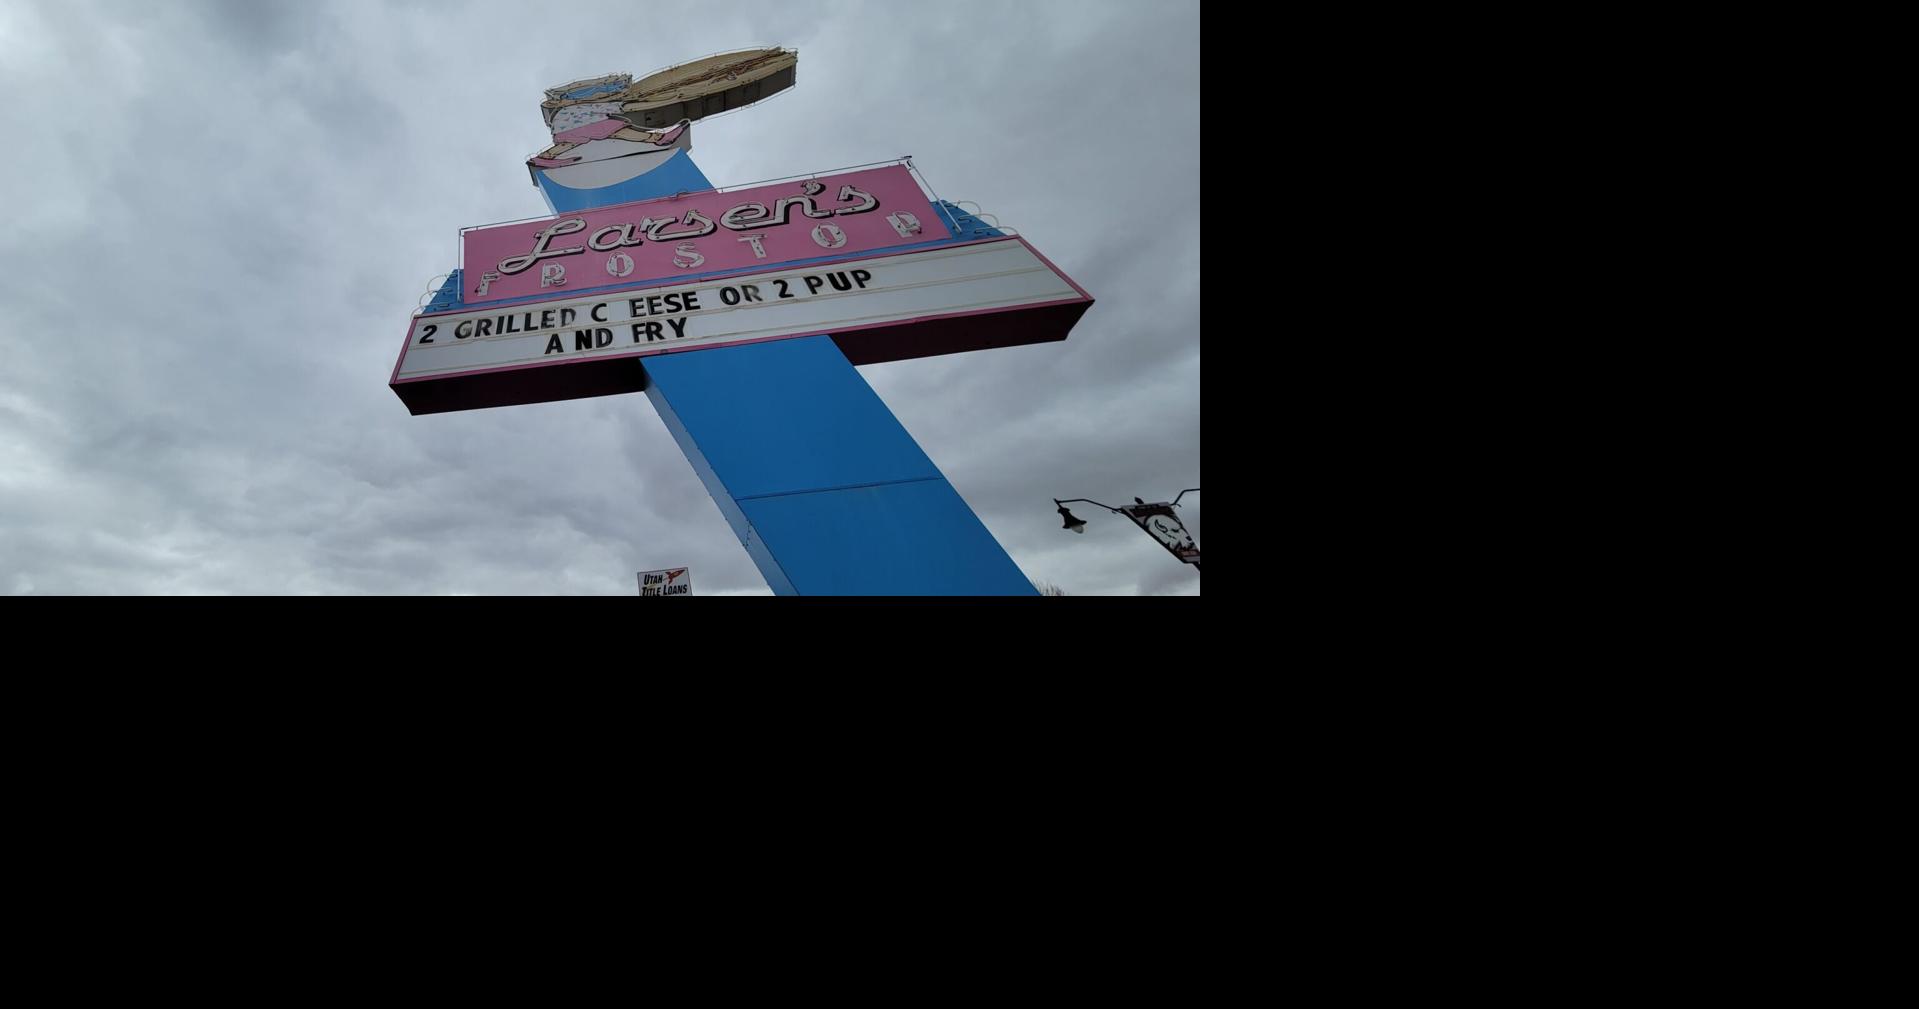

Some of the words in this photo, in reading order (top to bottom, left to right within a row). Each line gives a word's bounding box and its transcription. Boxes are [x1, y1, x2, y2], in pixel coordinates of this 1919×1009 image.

[474, 211, 923, 297] FROSTOP
[497, 180, 880, 275] Larsen's
[418, 324, 438, 344] 2
[454, 307, 576, 339] GRILLED
[719, 285, 764, 306] OR
[772, 279, 795, 299] 2
[803, 269, 872, 295] PUP
[631, 317, 687, 343] FRY
[663, 584, 688, 596] LOANS
